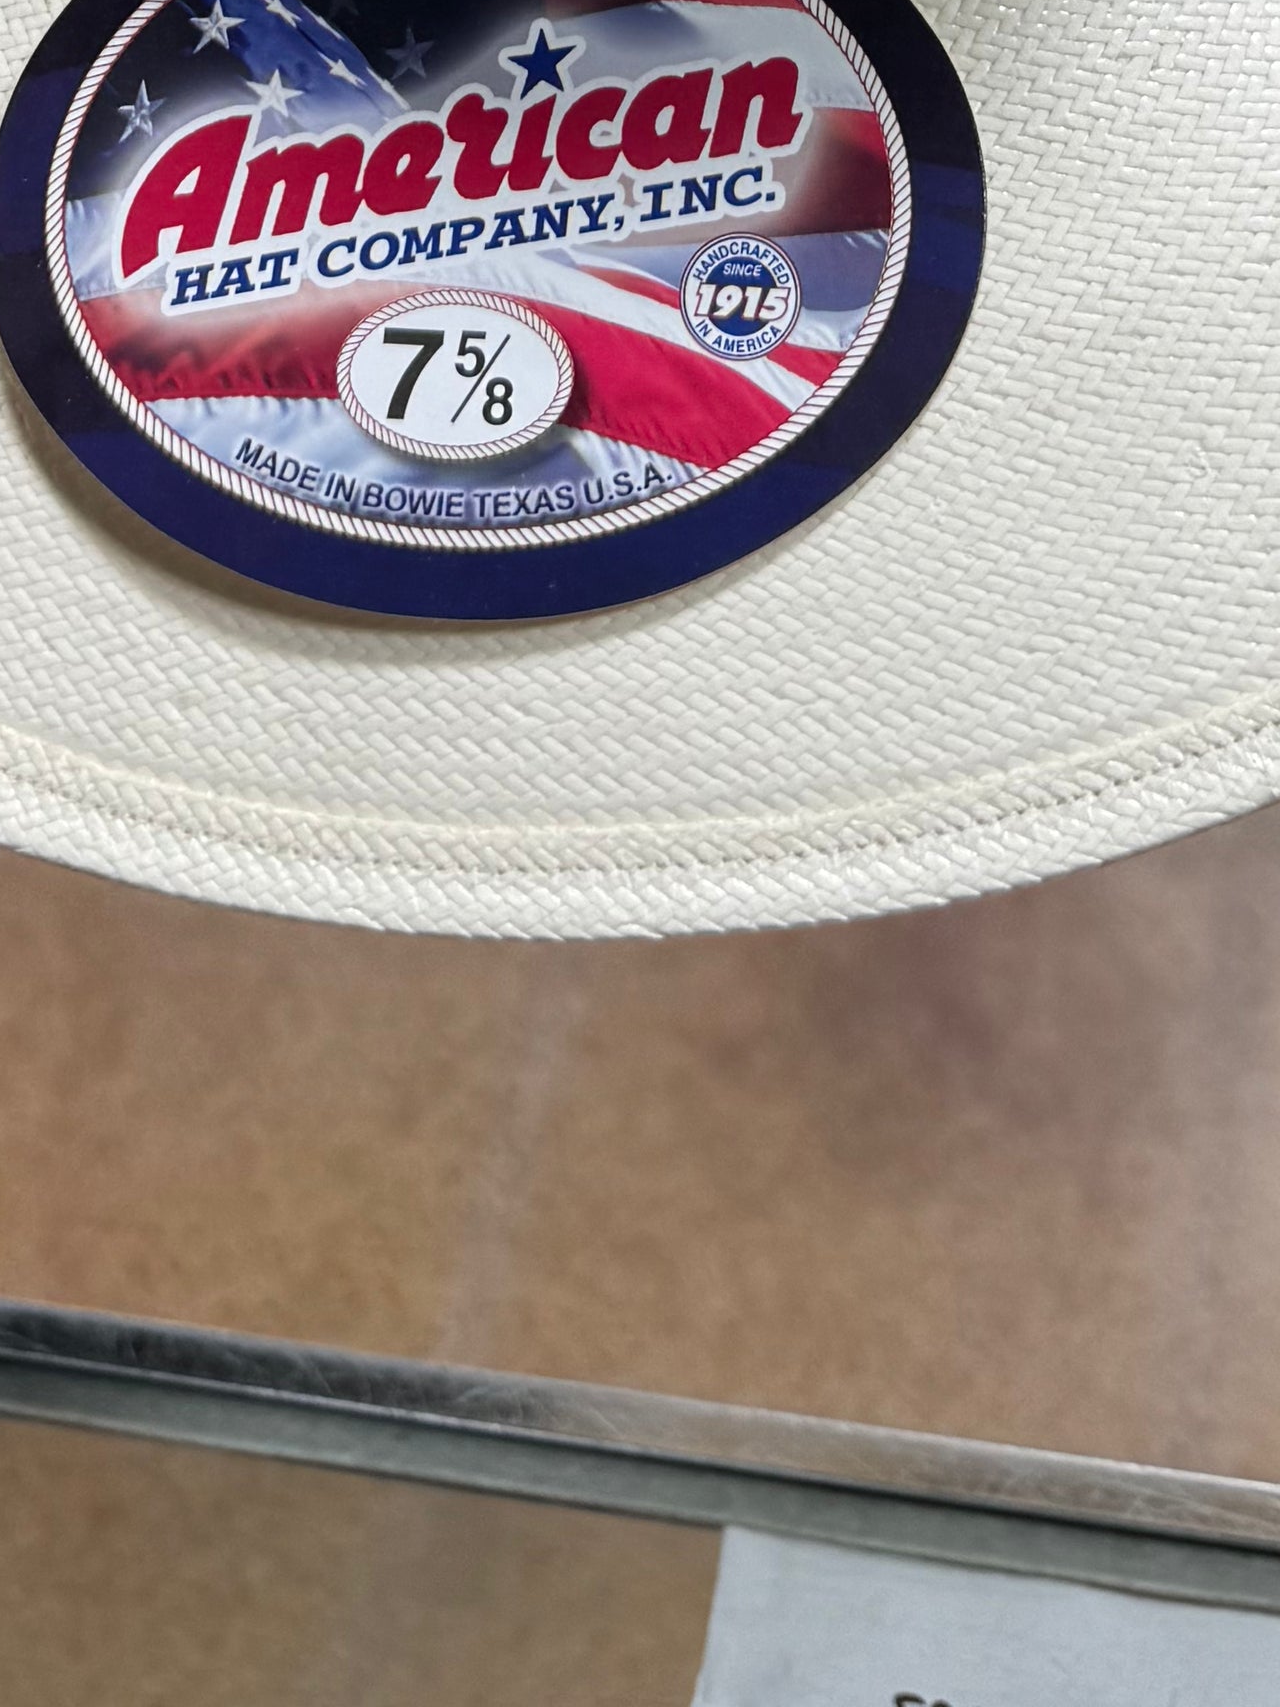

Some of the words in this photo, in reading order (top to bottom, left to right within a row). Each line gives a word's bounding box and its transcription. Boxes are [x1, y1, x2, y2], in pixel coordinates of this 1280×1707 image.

[121, 29, 803, 279] American
[170, 248, 299, 306] HAT
[318, 191, 624, 279] COMPANY,
[641, 165, 776, 220] INC.
[693, 241, 790, 285] HANDCRAFTED
[723, 263, 762, 277] SINCE
[694, 282, 791, 322] 1915
[695, 319, 713, 338] IN
[712, 324, 782, 353] AMERICA
[382, 327, 445, 420] 7
[234, 437, 321, 490] MADE
[323, 472, 356, 503] IN
[361, 484, 464, 519] BOWIE
[472, 484, 575, 519] TEXAS
[583, 461, 674, 505] U.S.A.
